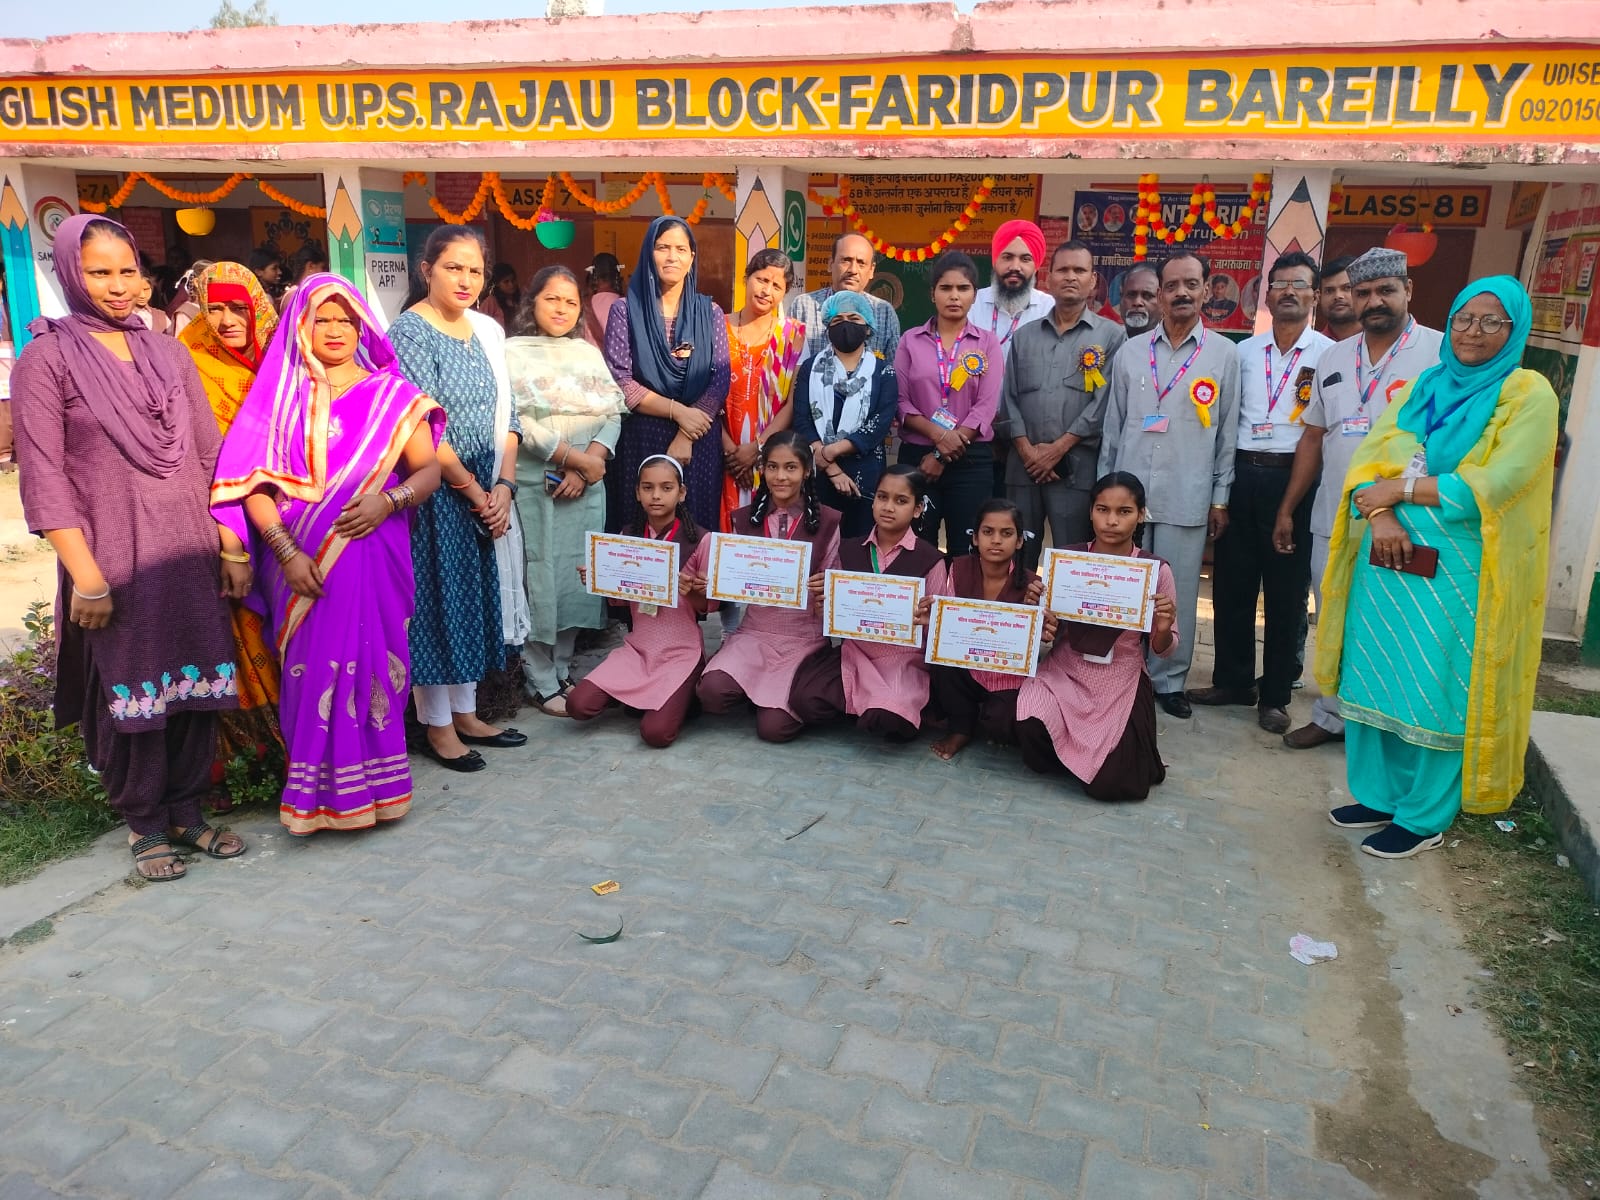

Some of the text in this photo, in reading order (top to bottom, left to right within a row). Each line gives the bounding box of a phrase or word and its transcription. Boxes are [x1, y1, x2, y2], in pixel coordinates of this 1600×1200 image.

[1543, 62, 1600, 87] UDISE
[130, 83, 304, 131] MEDIUM
[1184, 62, 1533, 128] BAREILLY
[928, 173, 988, 183] COTPA-200
[907, 188, 922, 199] एक
[371, 260, 406, 273] PRERNA
